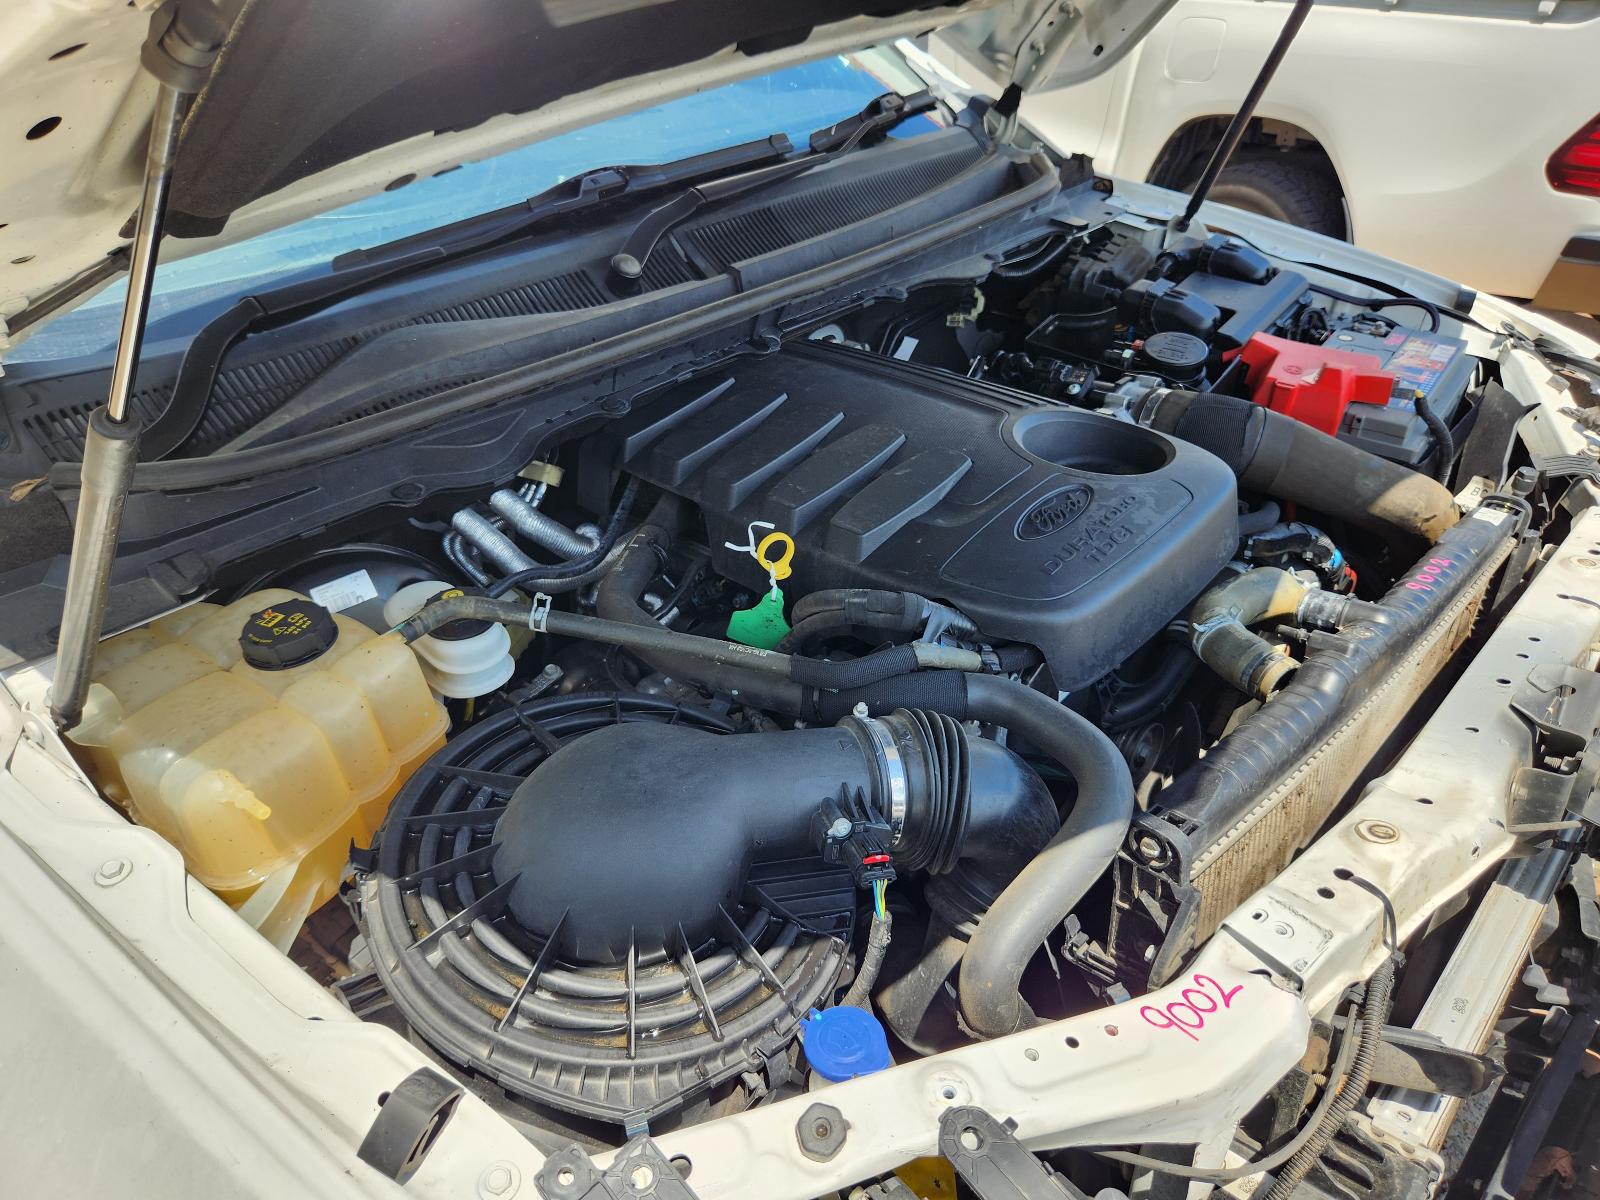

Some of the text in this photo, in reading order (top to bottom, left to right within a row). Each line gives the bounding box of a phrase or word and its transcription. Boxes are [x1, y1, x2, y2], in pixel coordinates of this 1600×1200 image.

[1030, 491, 1083, 532] Ford
[1405, 558, 1452, 591] 9002
[1140, 974, 1244, 1041] 9002
